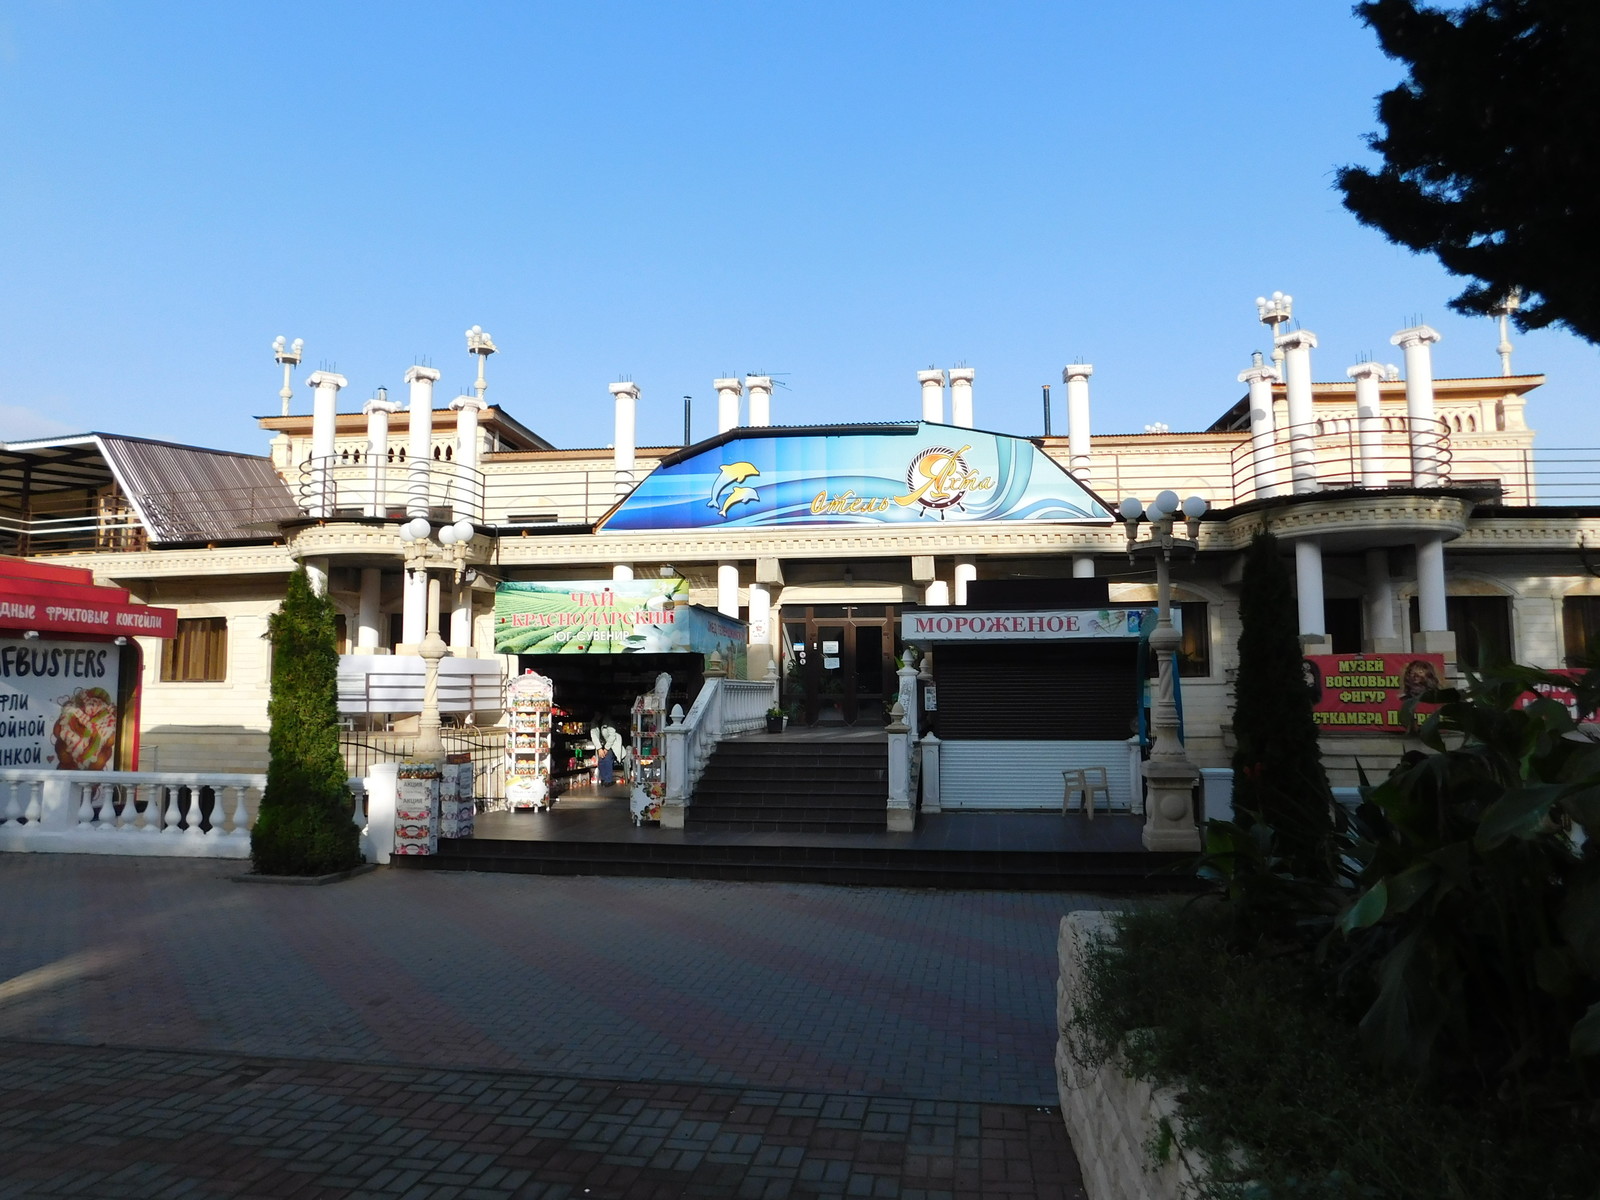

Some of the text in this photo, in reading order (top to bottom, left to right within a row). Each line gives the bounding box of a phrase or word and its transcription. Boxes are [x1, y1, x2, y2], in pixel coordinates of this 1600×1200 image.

[810, 444, 996, 515] Отель Яхта
[570, 590, 615, 607] ЧАЙ
[511, 610, 677, 627] КРАСНОДАРСКИЙ
[914, 615, 1081, 633] МОРОЖЕНОЕ
[553, 630, 630, 642] ЮГ-СУВЕНИР
[0, 645, 107, 678] FBUSTERS
[1338, 658, 1385, 673] МУЗЕЙ
[1325, 675, 1400, 688] ВОСКОВЫХ
[1339, 690, 1386, 703] ФИГУР
[1312, 711, 1383, 725] СТКАМЕРА
